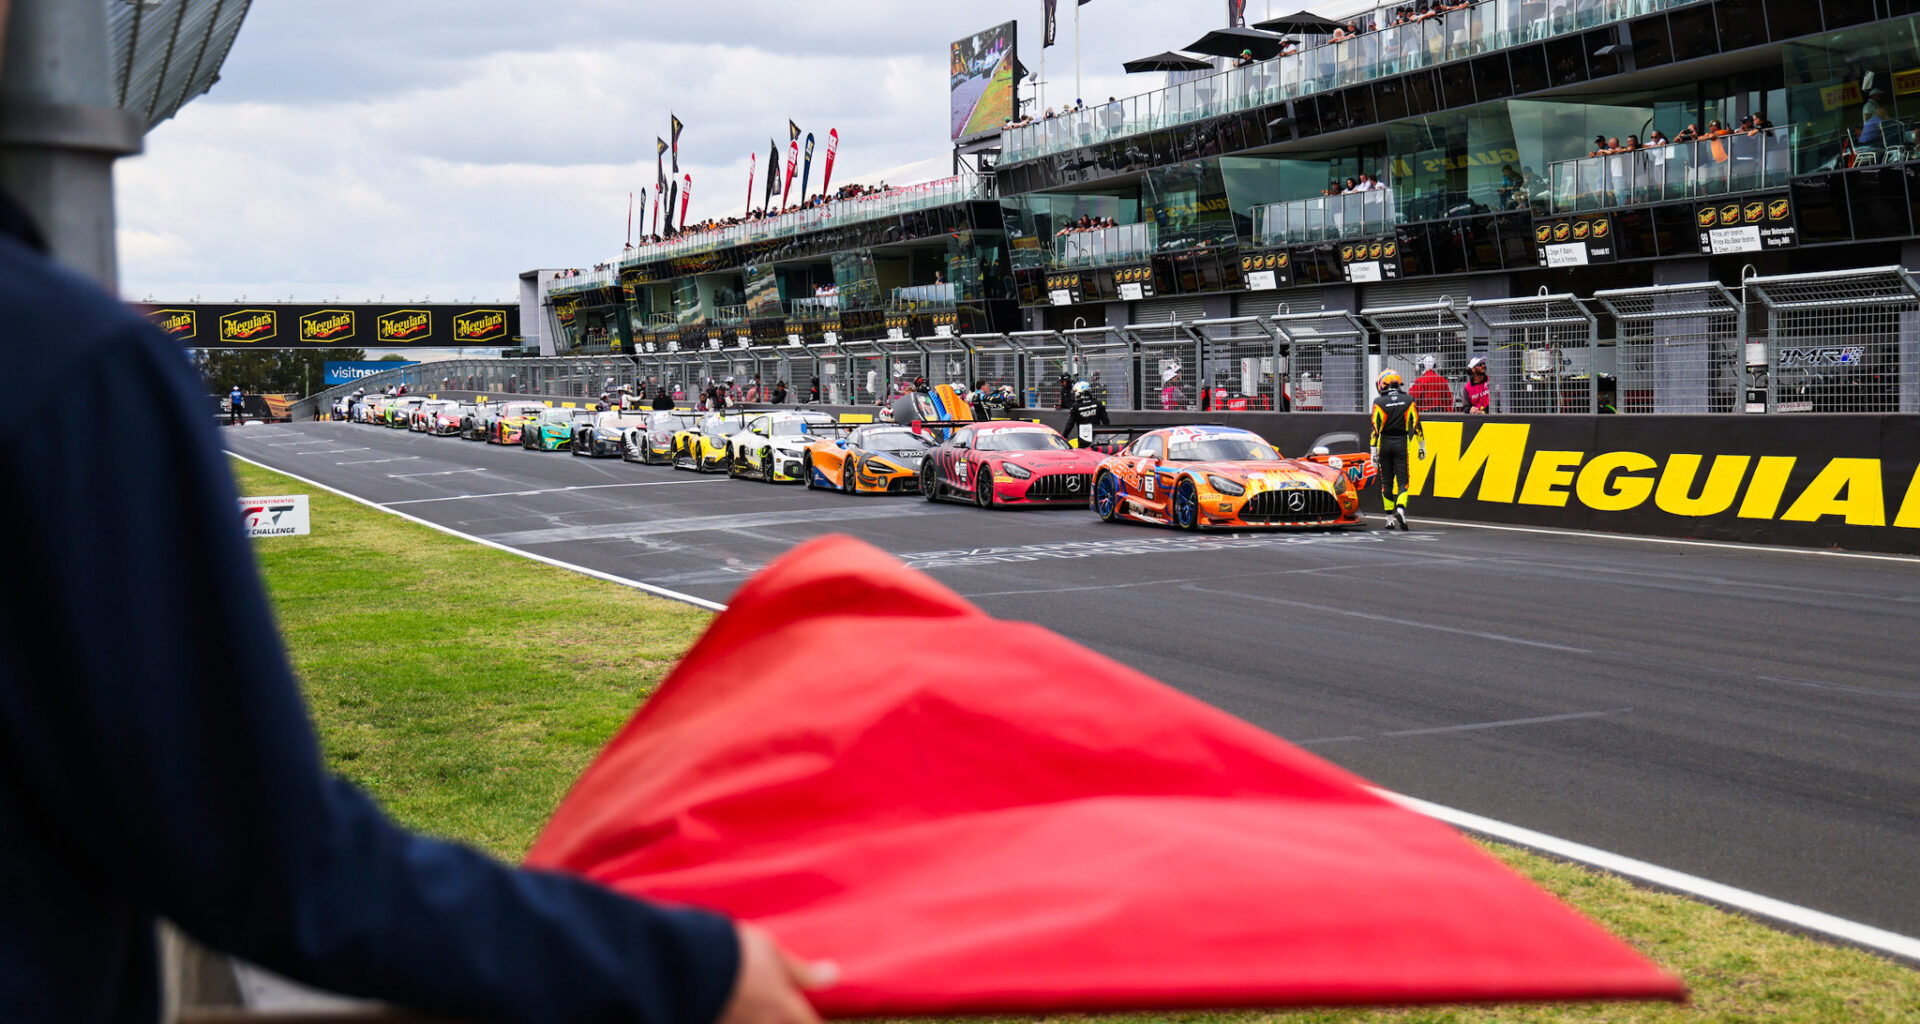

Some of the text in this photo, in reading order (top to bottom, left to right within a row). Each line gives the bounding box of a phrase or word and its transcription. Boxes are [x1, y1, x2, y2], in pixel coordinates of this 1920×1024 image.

[161, 313, 192, 330] guiar's
[223, 313, 273, 338] Meguiar's
[303, 313, 351, 338] Meguiar's
[381, 312, 428, 338] Meguiar's
[457, 312, 503, 338] Meguiar's
[252, 527, 296, 536] CHALLENGE
